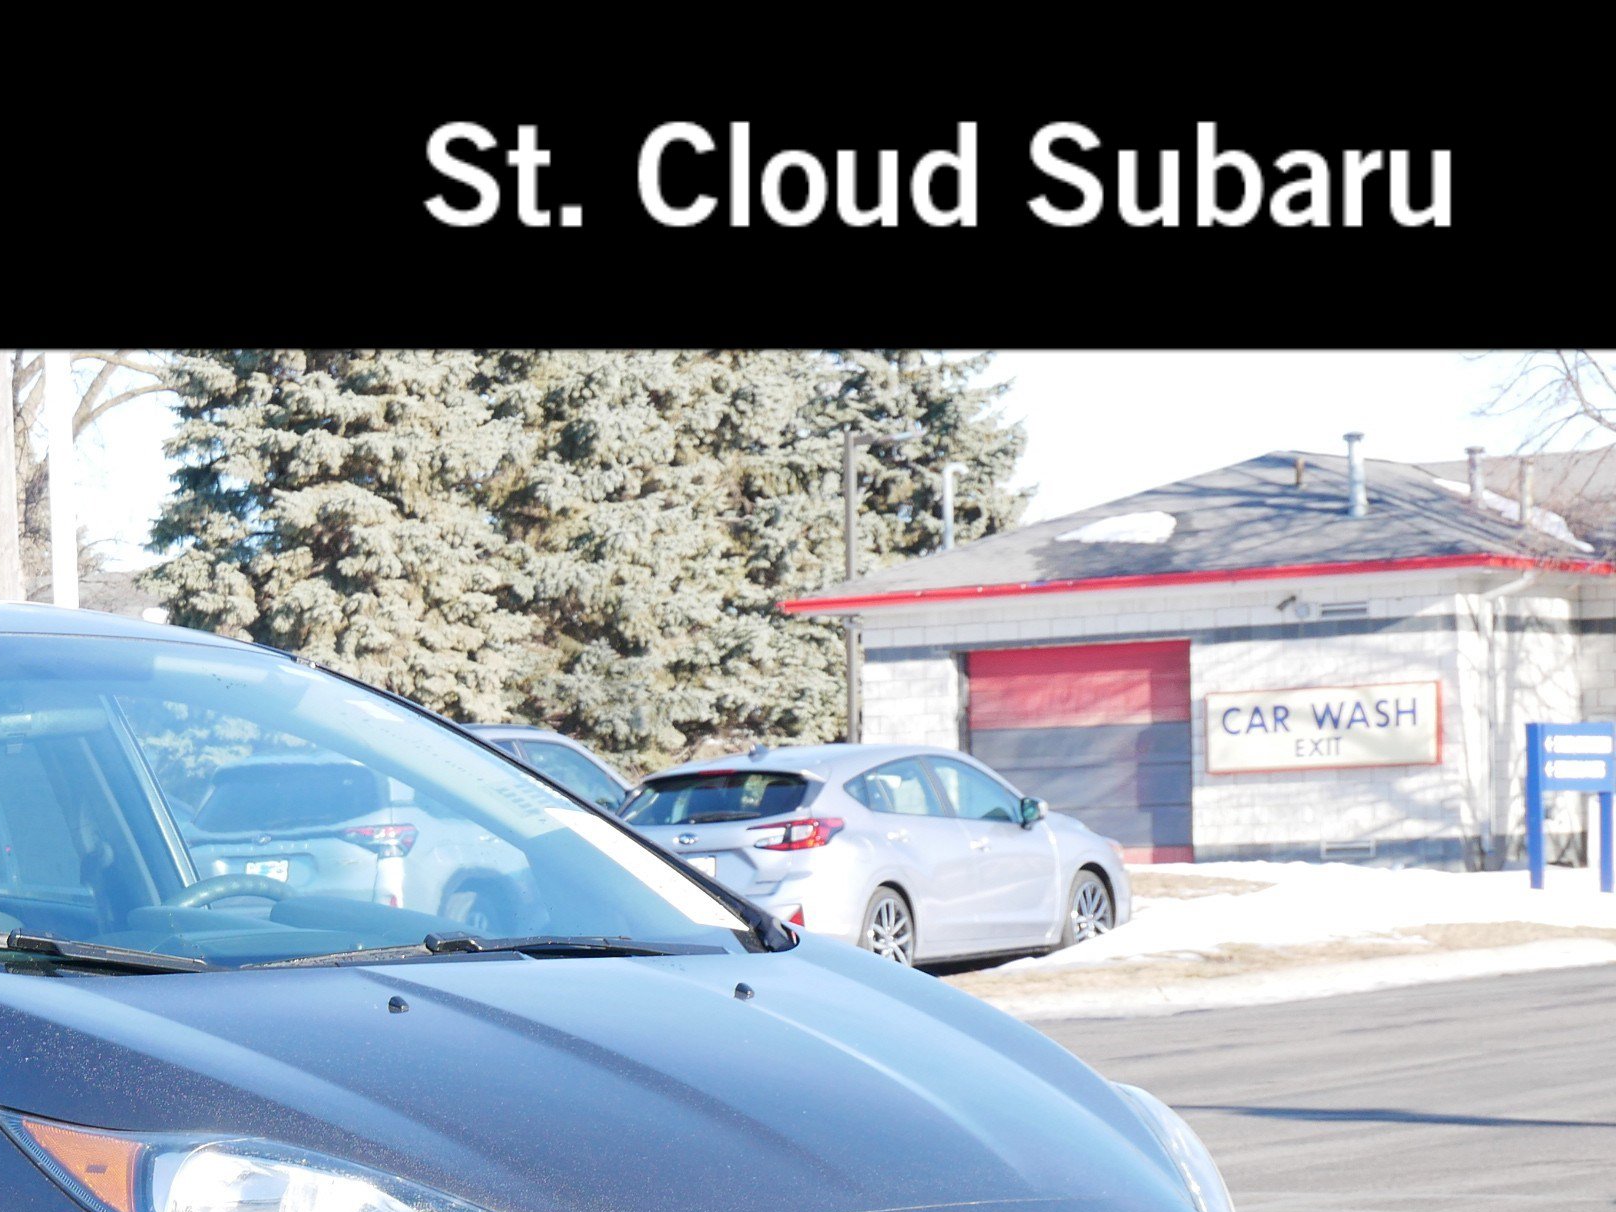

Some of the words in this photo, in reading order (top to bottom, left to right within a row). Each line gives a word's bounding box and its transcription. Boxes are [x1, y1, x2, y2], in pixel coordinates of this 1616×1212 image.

[1222, 705, 1290, 734] CAR
[1312, 698, 1417, 729] WASH
[1295, 736, 1343, 757] EXIT
